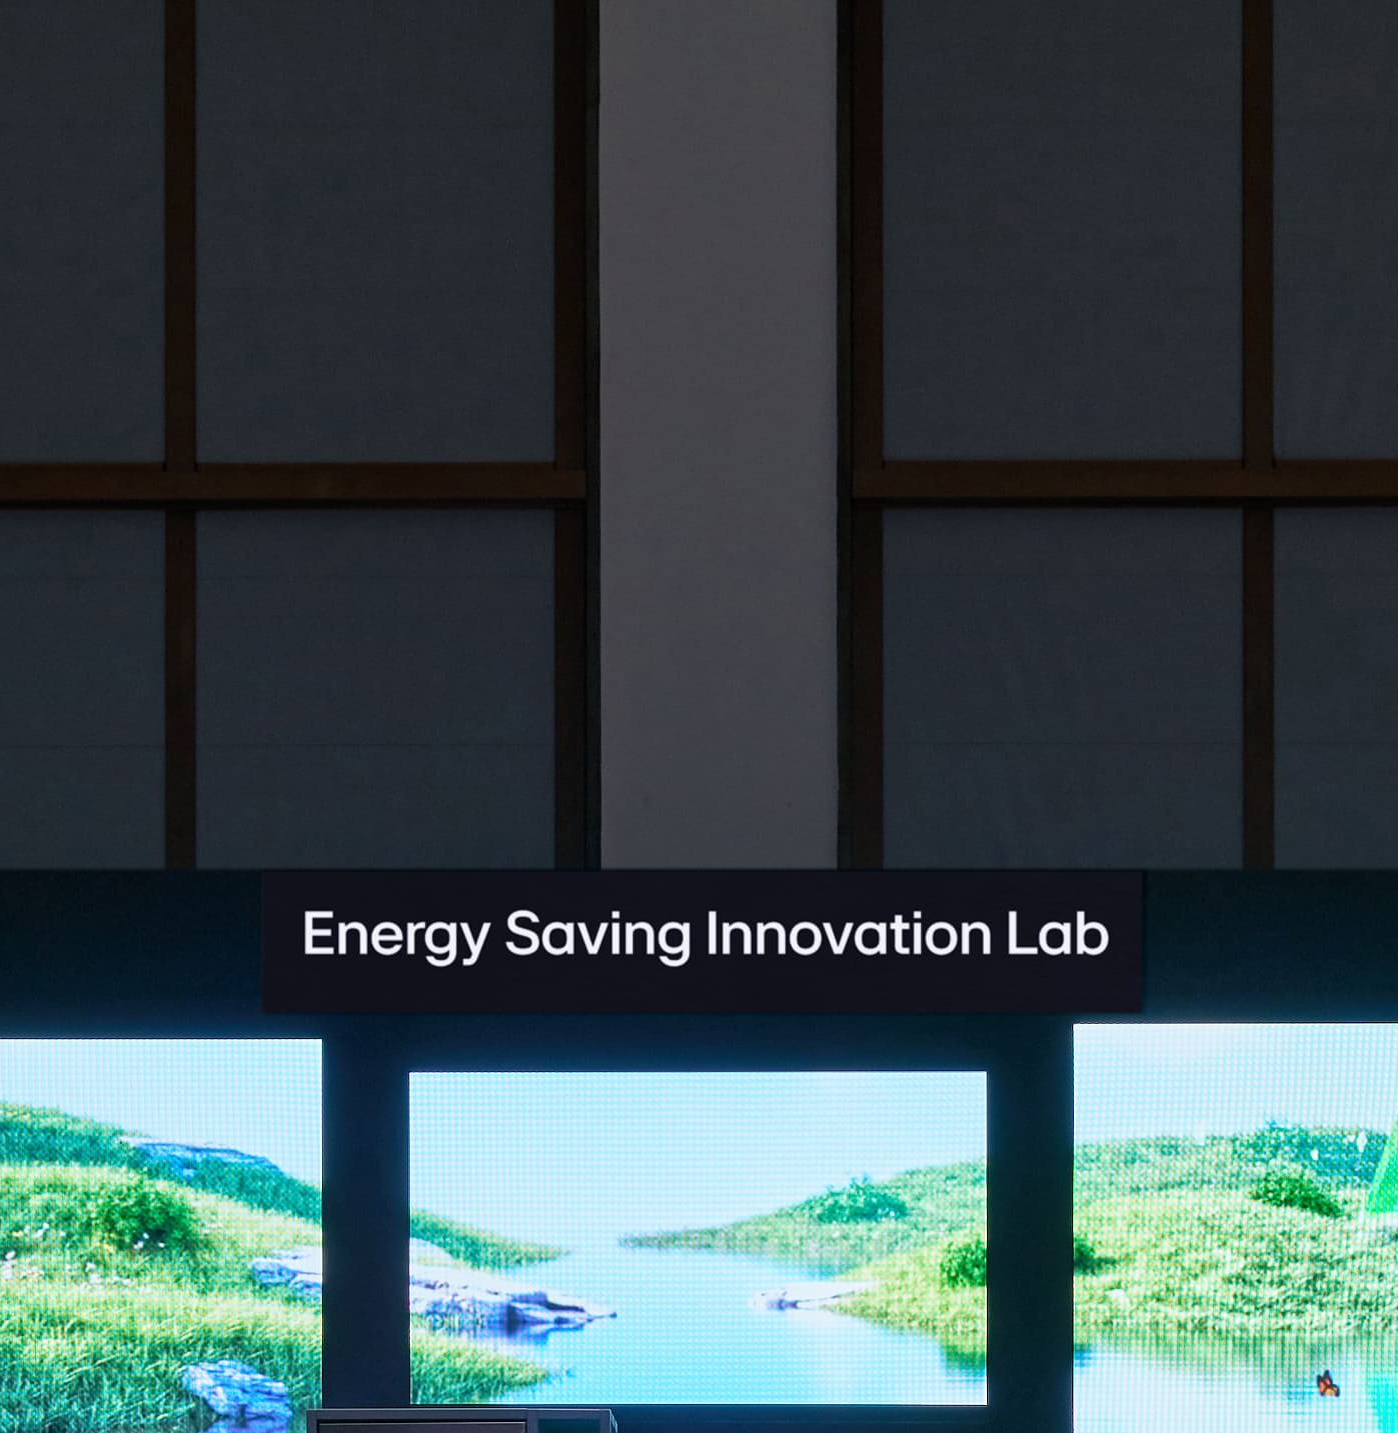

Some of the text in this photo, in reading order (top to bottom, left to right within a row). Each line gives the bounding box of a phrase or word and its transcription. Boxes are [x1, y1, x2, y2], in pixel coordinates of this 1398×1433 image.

[304, 909, 1109, 967] Energy Saving Innovation Lab
